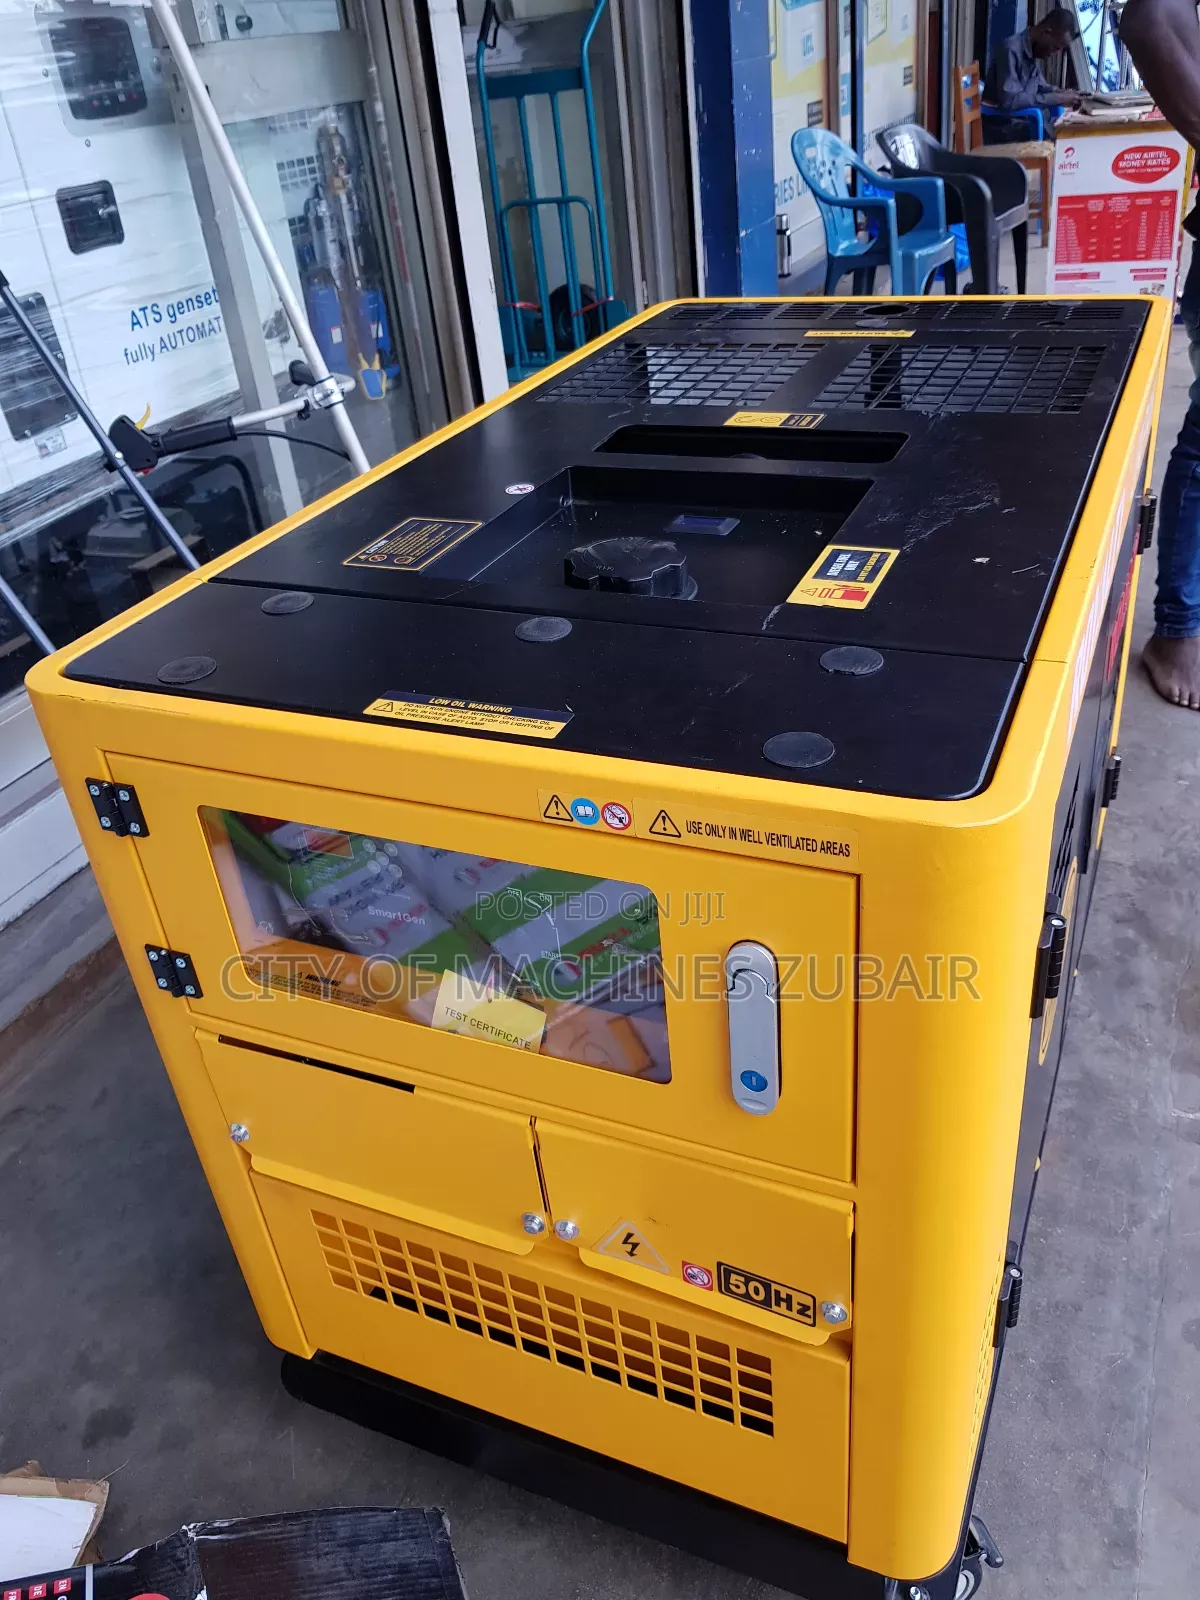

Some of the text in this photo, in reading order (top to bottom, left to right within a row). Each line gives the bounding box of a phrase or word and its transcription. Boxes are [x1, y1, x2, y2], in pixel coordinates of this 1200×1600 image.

[130, 286, 219, 332] ATS genset
[123, 342, 155, 366] fully
[428, 697, 451, 706] LOW
[467, 702, 513, 714] WARNING
[406, 712, 442, 721] PRESSURE
[502, 715, 539, 724] CHECKING
[685, 819, 851, 858] USE ONLY IN WELL VENTILATED AREAS
[367, 905, 427, 926] SmartGen
[444, 1006, 532, 1051] TEST CERTIFICATE
[728, 1272, 766, 1302] 50
[33, 1585, 43, 1597] DE
[58, 1579, 68, 1591] EN
